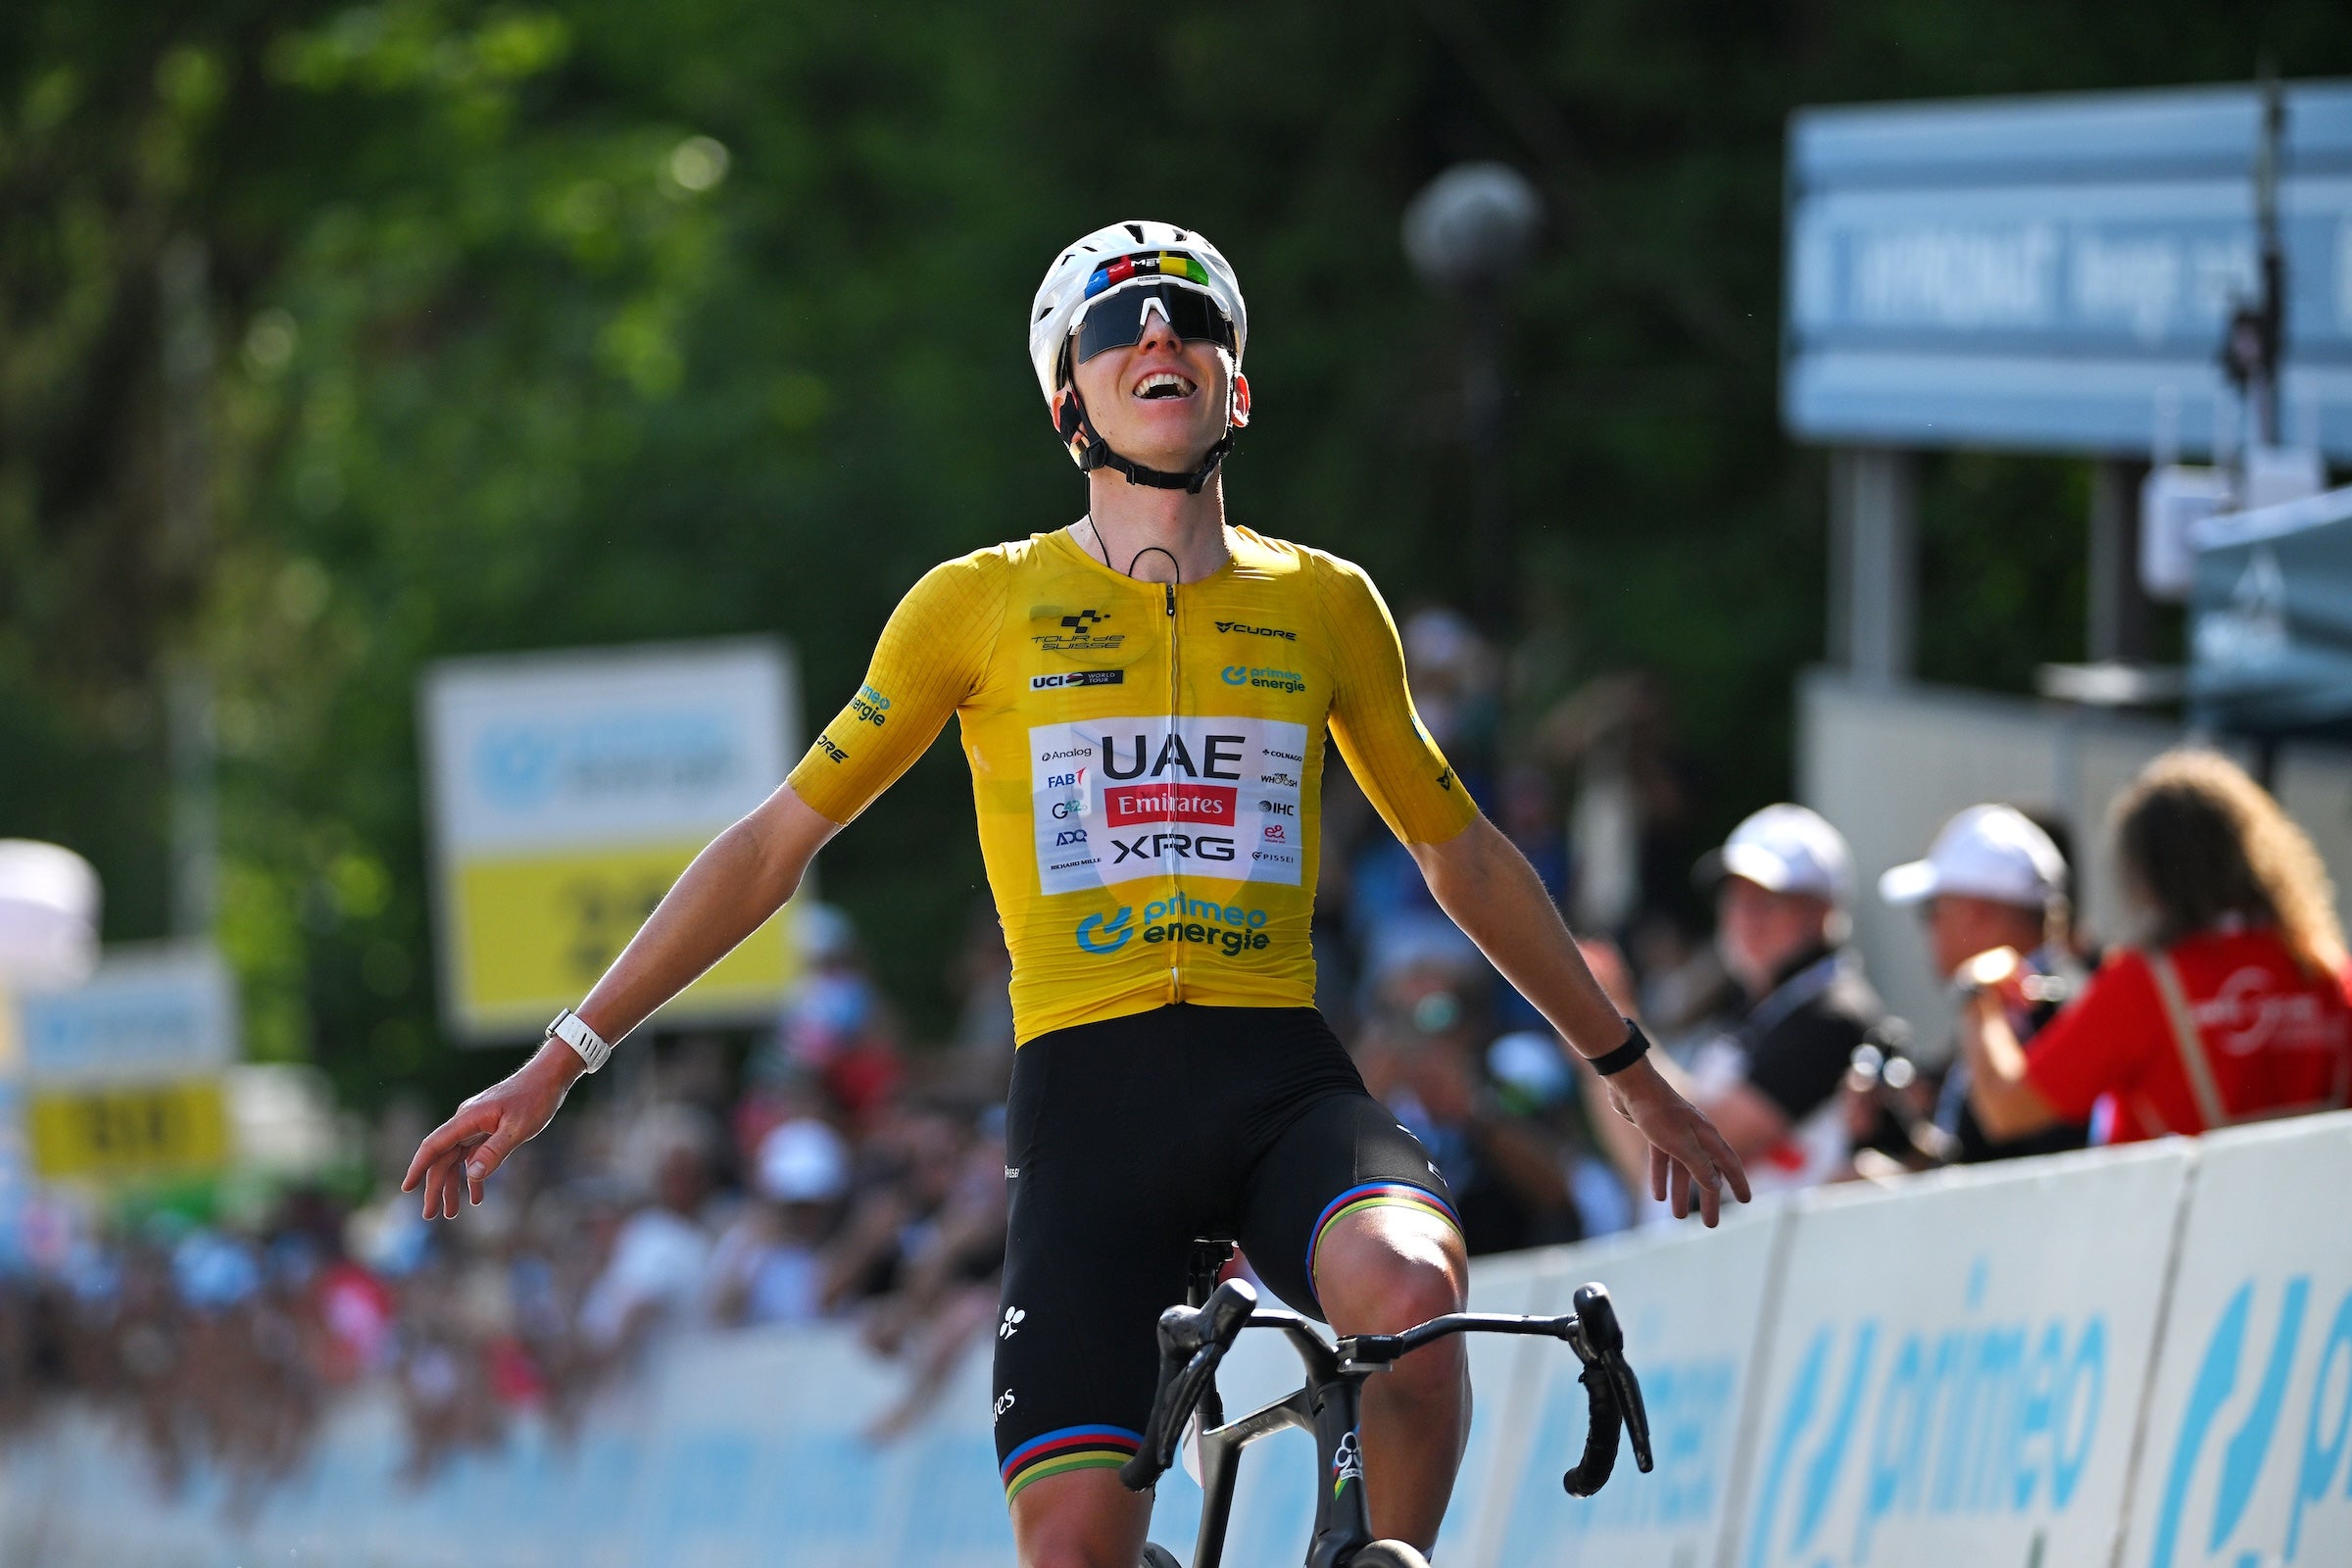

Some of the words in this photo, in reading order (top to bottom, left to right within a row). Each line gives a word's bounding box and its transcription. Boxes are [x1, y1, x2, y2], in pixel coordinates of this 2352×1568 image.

[1234, 624, 1297, 641] CUORE
[1033, 676, 1063, 688] UCI
[1250, 667, 1301, 680] primeo
[1251, 678, 1305, 693] energie
[860, 683, 891, 710] meo
[850, 697, 886, 726] nergie
[817, 734, 850, 763] ORE
[1053, 748, 1092, 760] Analog
[1102, 734, 1246, 780] UAE
[1270, 751, 1302, 761] COLNAGO
[1053, 800, 1082, 819] G42
[1117, 793, 1223, 815] Emirates
[1273, 803, 1294, 815] IHC
[1056, 829, 1088, 846] ADQ
[1110, 834, 1235, 864] XRG
[1051, 861, 1080, 870] RICHARD
[1263, 854, 1294, 863] PISSEI
[1144, 891, 1267, 928] primeo
[1143, 923, 1270, 956] energie
[1852, 1255, 2109, 1566] primeo
